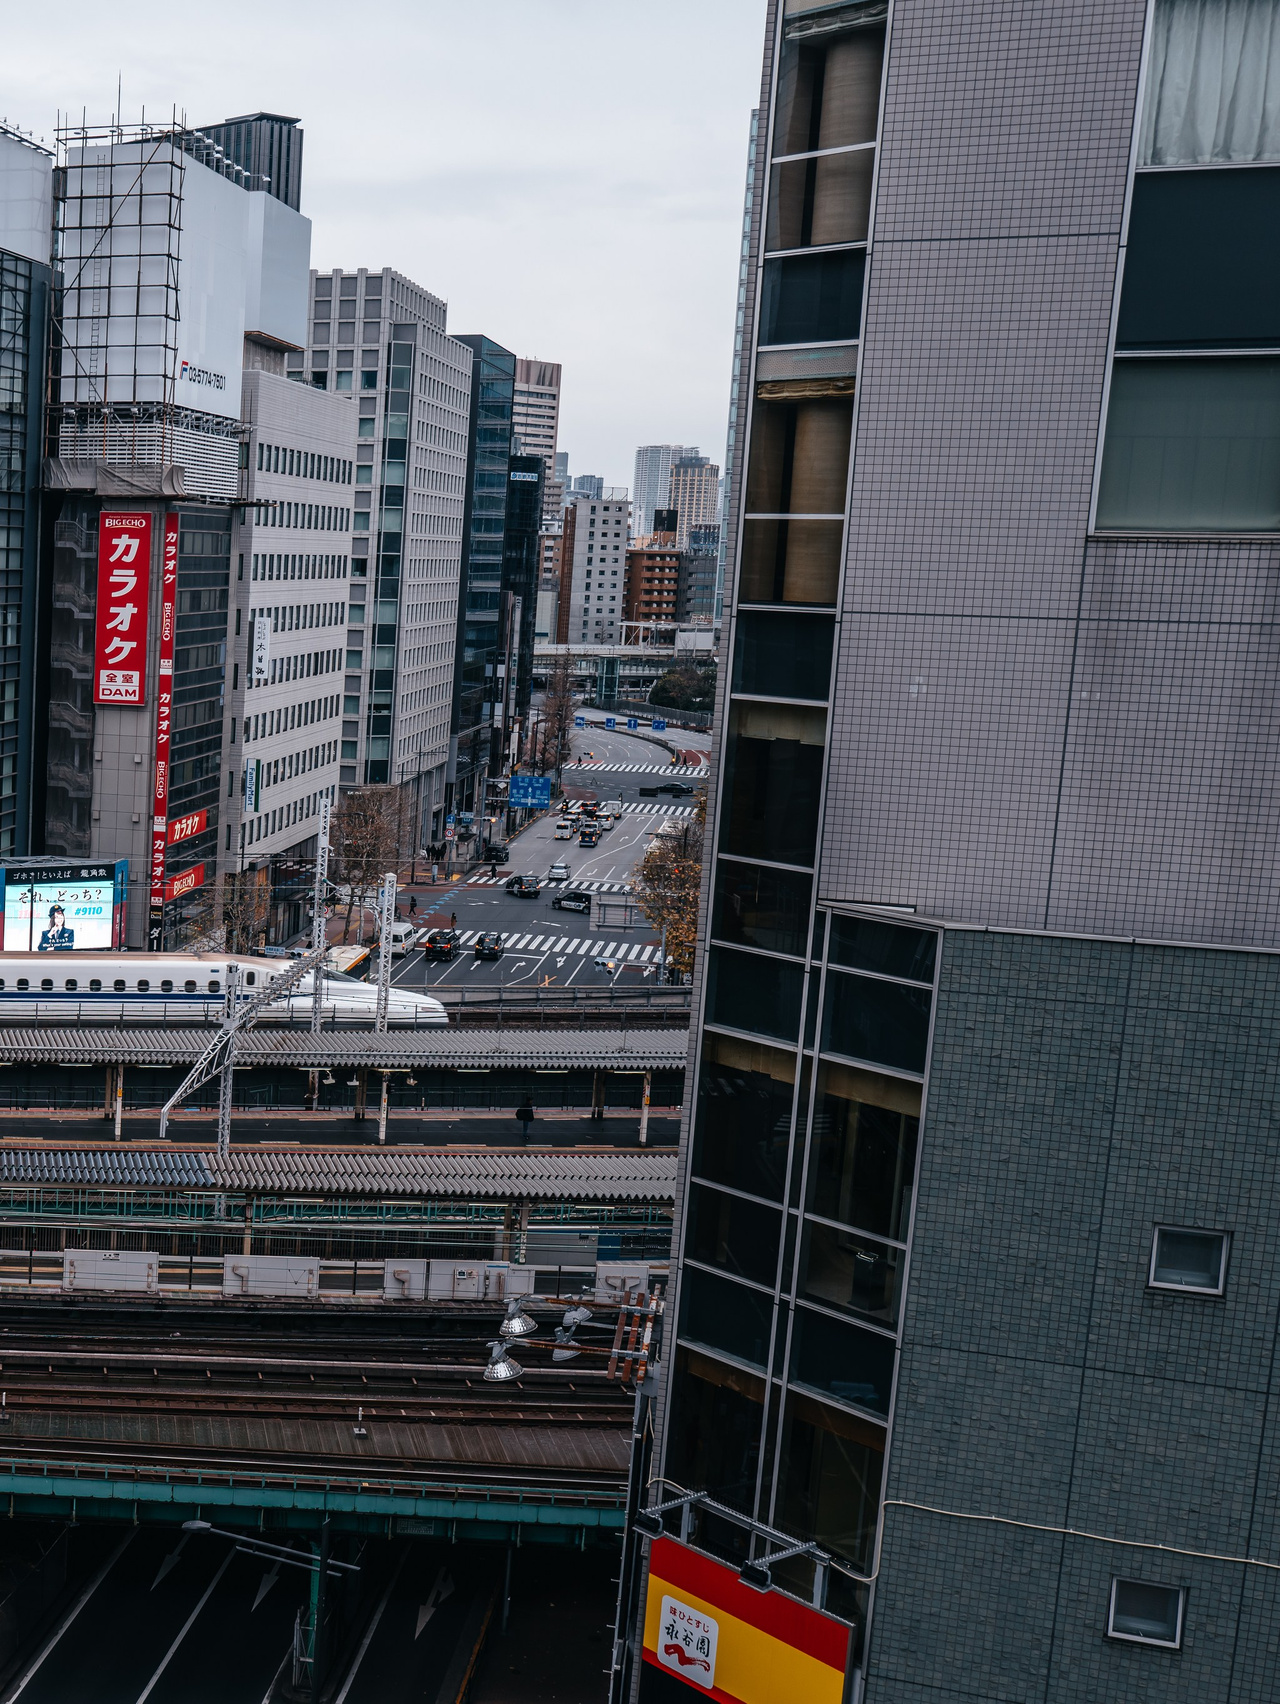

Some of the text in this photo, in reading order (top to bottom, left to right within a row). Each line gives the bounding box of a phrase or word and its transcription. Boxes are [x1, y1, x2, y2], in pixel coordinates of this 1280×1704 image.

[105, 518, 146, 528] BIG ECHO
[163, 532, 177, 584] カラオケ
[104, 534, 141, 665] カラオケ
[162, 602, 172, 641] BIG ECHO
[101, 687, 137, 698] DAM
[105, 672, 134, 684] 全室
[157, 692, 170, 744] カラオケ
[156, 761, 165, 799] BIG ECHO
[247, 767, 256, 806] FamilyMart
[174, 816, 200, 840] カラオケ
[151, 839, 164, 888] カラオケ
[18, 888, 102, 904] それ、どっち?
[173, 873, 195, 896] BIG ECHO
[74, 906, 103, 916] #9110
[669, 1605, 710, 1634] 味ひとすじ
[664, 1618, 711, 1658] 永谷園
